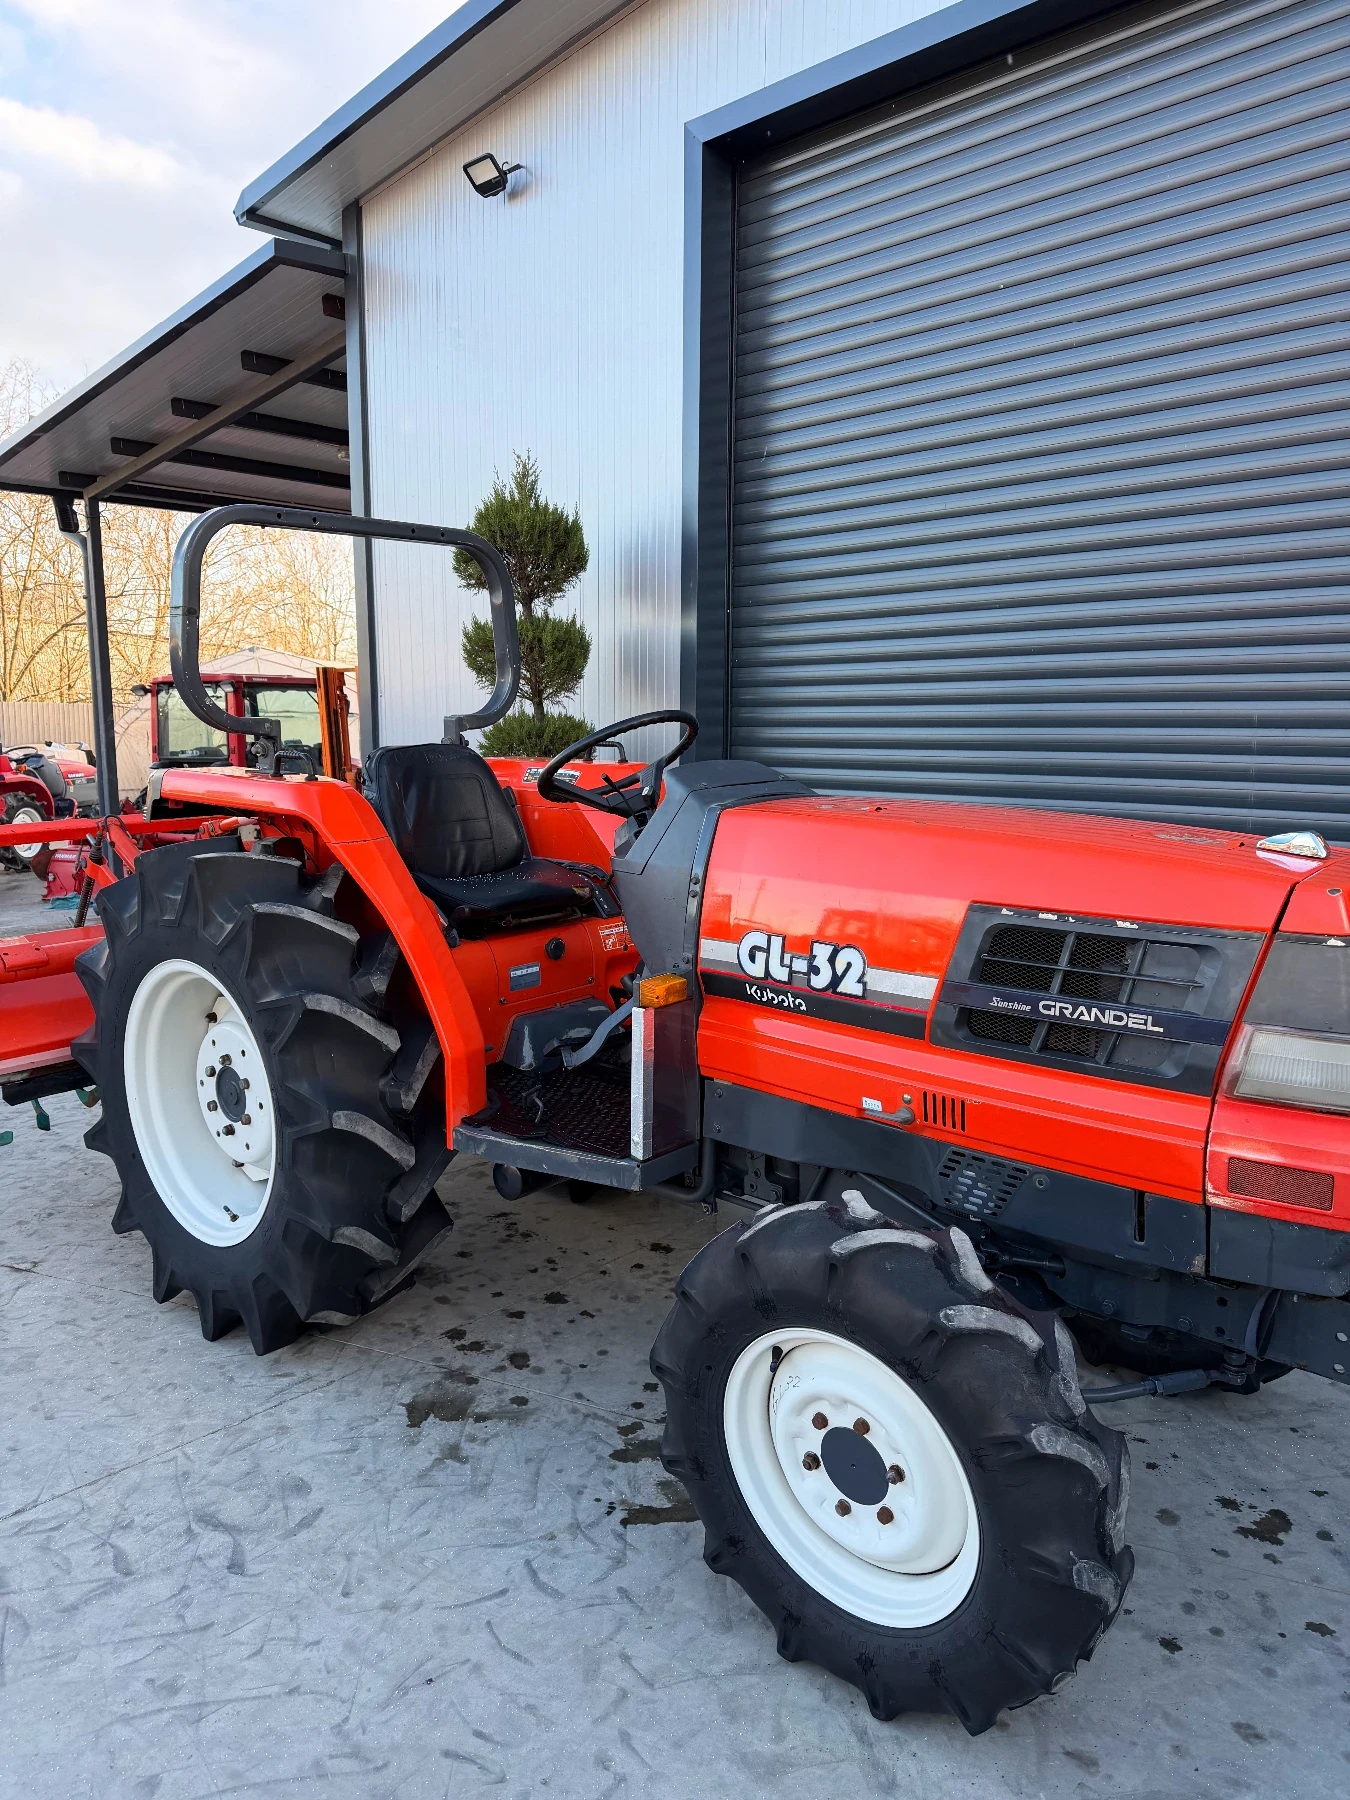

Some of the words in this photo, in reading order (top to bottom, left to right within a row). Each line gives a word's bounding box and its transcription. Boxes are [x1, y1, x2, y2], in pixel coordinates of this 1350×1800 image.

[737, 930, 867, 999] GL-32
[745, 983, 807, 1011] Kubota
[989, 996, 1032, 1012] Sunshine
[1038, 1000, 1164, 1032] GRANDEL
